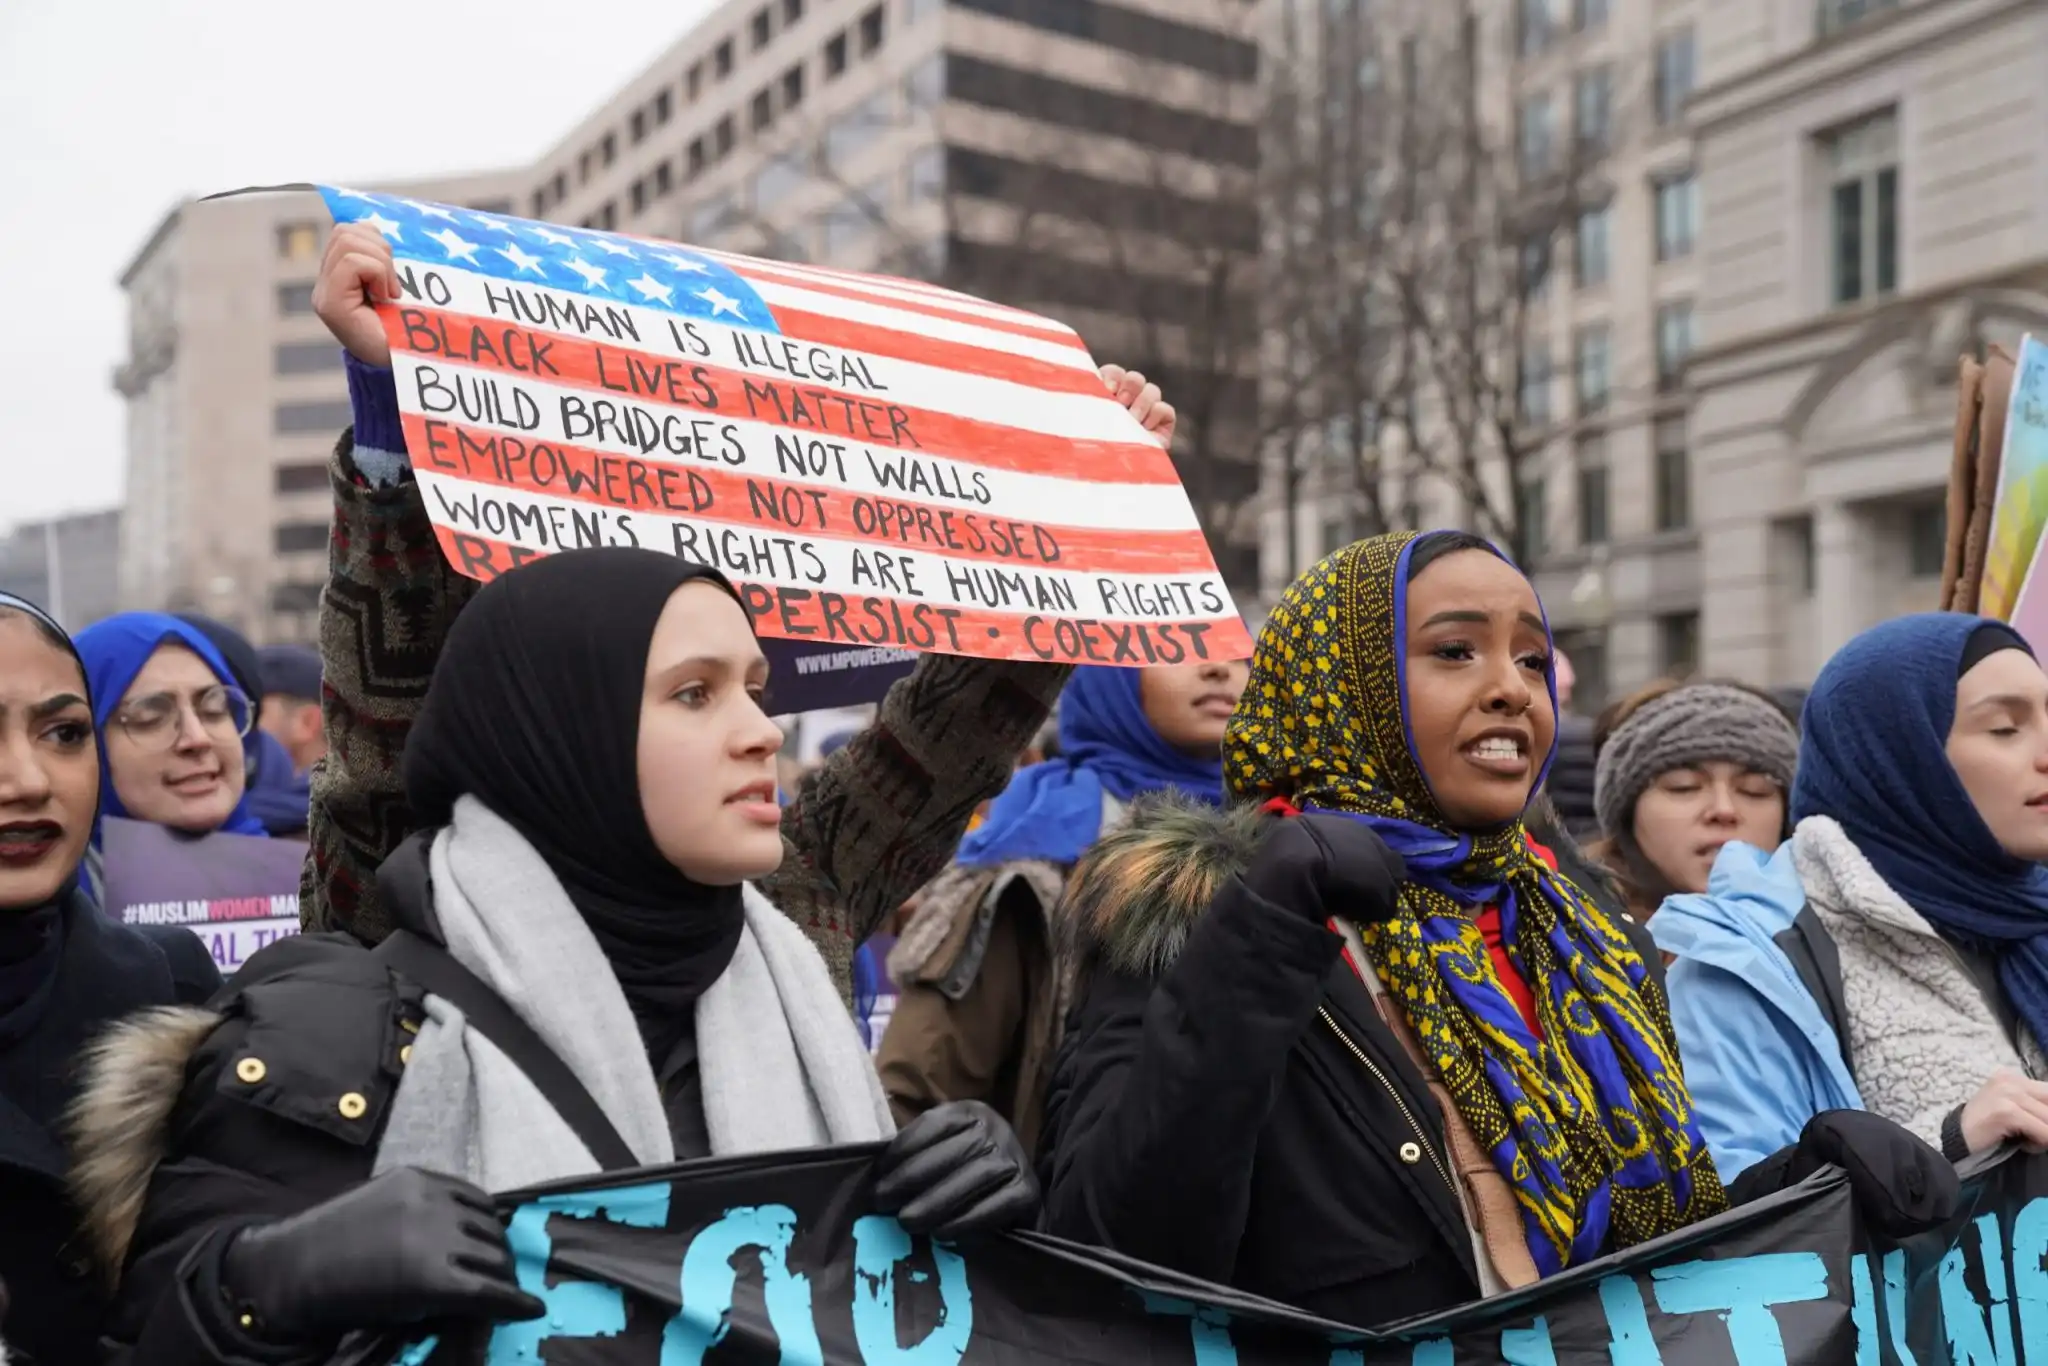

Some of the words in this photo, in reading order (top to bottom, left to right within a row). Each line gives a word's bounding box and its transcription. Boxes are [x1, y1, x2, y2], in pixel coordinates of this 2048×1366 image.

[397, 265, 452, 306] NO
[484, 281, 641, 342] HUMAN
[668, 319, 711, 357] IS
[732, 331, 888, 390] ILLEGAL
[400, 309, 560, 377] BLACK
[596, 347, 719, 409] LIVES
[742, 378, 921, 448] MATTER
[415, 366, 541, 431] BUILD
[560, 396, 746, 465] BRIDGES
[775, 434, 846, 483] NOT
[866, 449, 991, 505] WALLS
[425, 420, 715, 513] EMPOWERED
[747, 479, 828, 530] NOT
[853, 498, 1061, 563] OPPRESSED
[433, 484, 640, 551] WOMEN'S
[672, 522, 827, 584] RIGHTS
[852, 548, 924, 597] ARE
[945, 560, 1078, 611] HUMAN
[1097, 577, 1225, 617] RIGHTS
[741, 582, 964, 653] PERSIST
[1024, 614, 1211, 664] COEXIST
[123, 893, 300, 924] #MUSLIMWOMENMA
